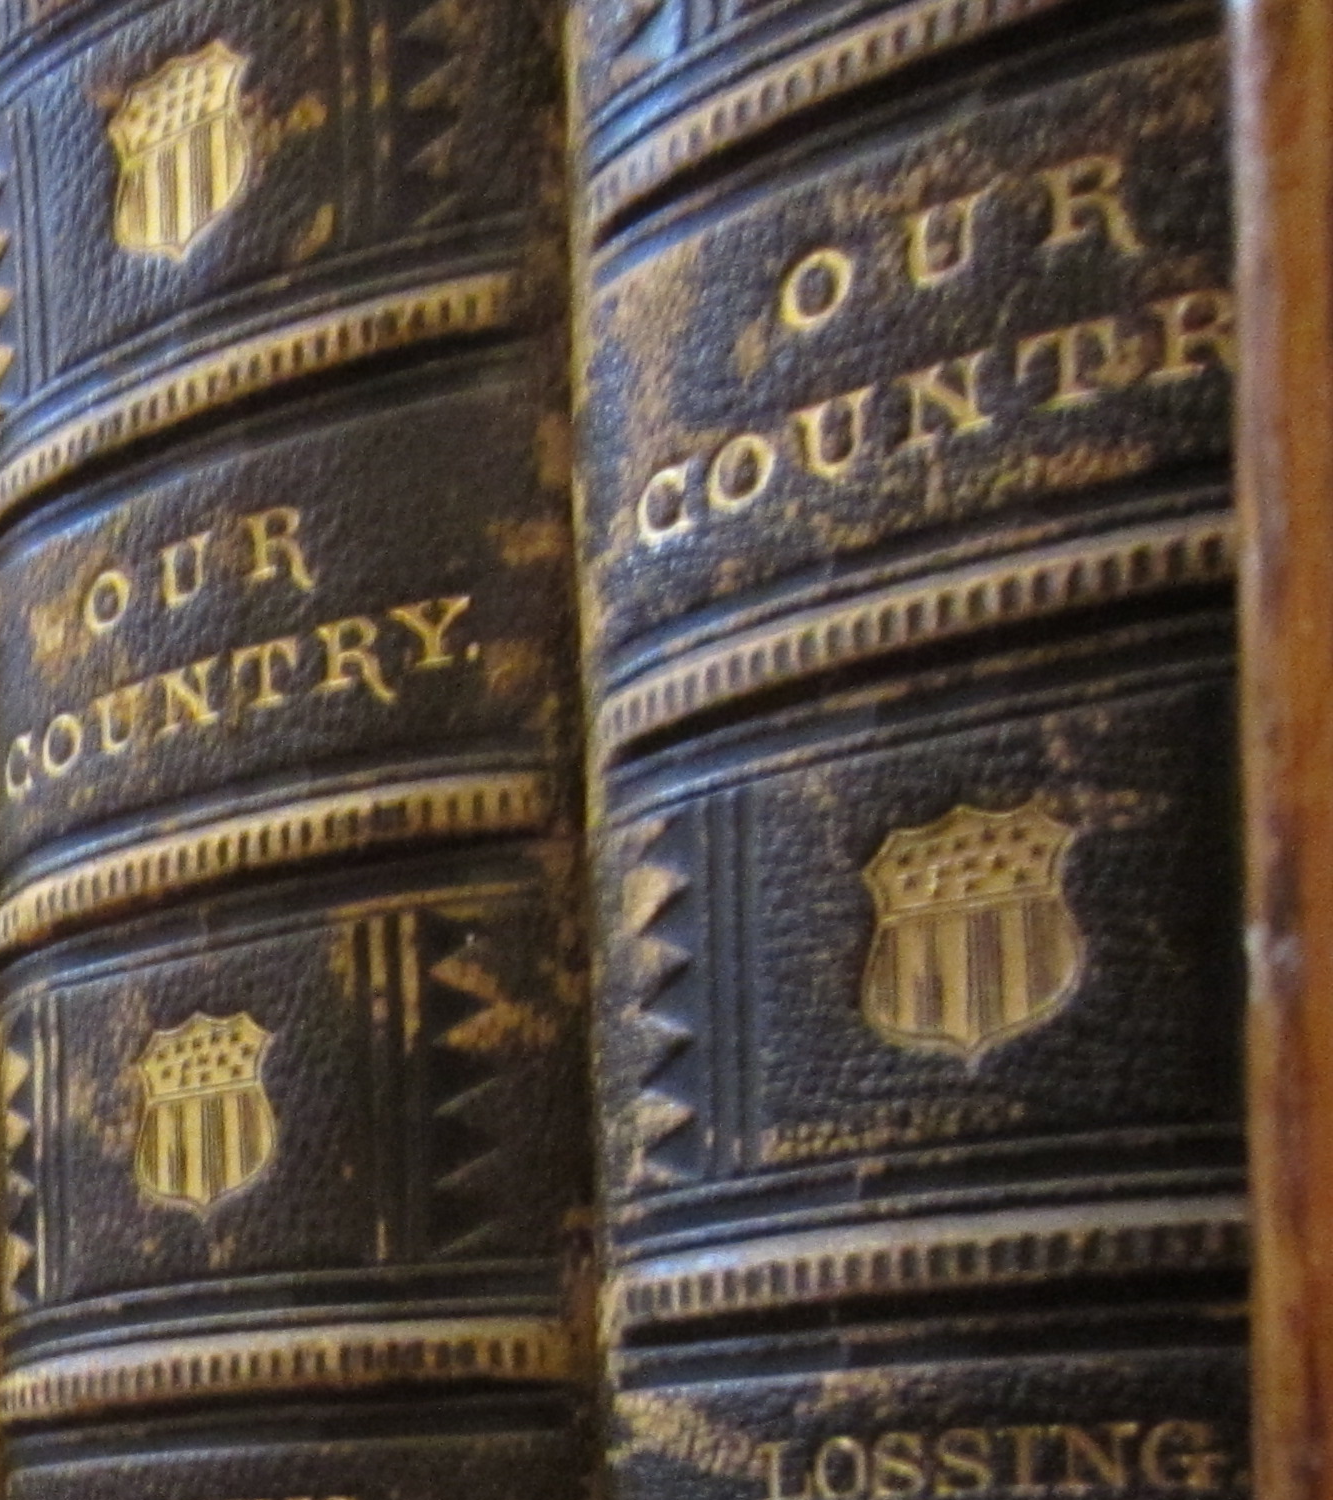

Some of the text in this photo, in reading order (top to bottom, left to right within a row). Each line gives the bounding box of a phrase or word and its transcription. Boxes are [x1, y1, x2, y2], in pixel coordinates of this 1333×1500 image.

[778, 152, 1146, 333] OUR
[83, 506, 318, 636] OUR
[4, 594, 482, 800] COUNTRY.
